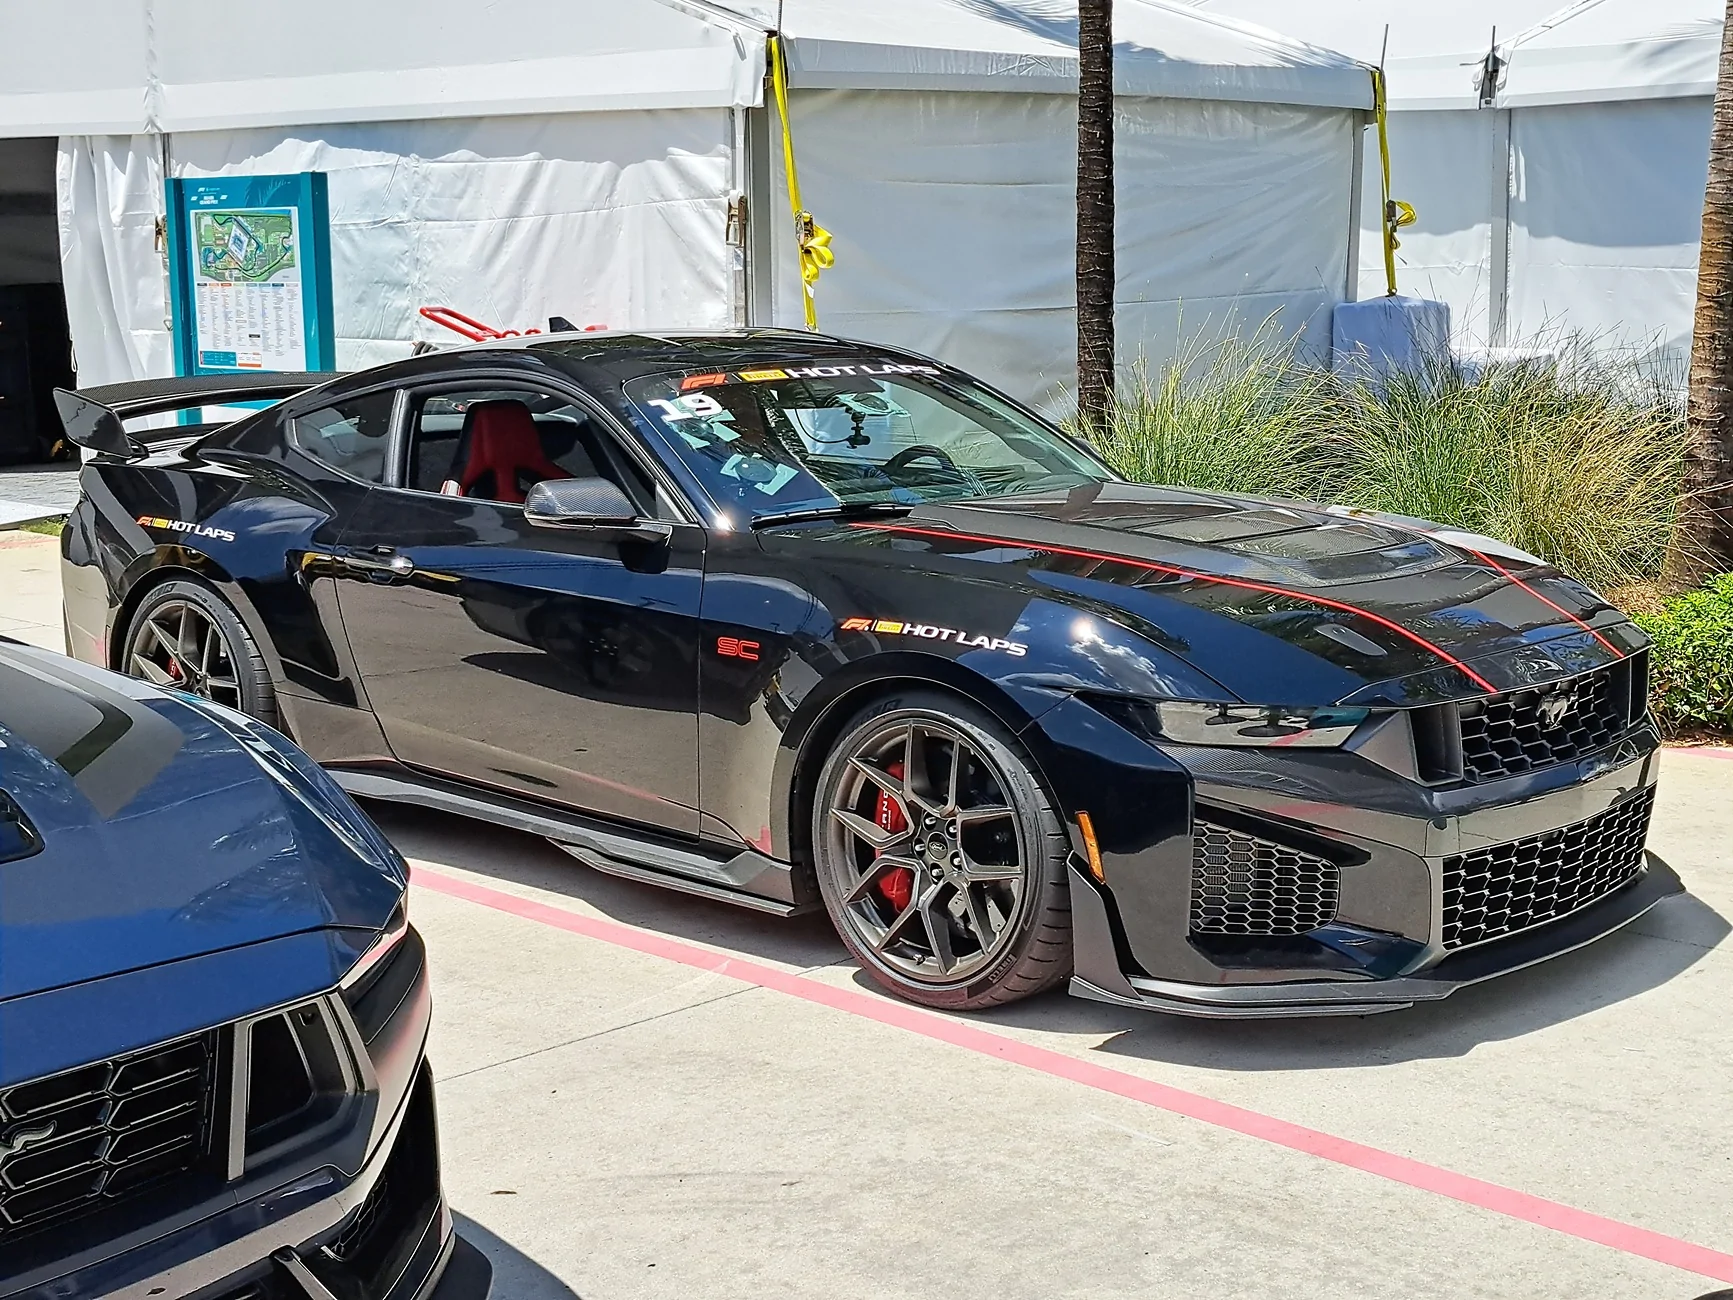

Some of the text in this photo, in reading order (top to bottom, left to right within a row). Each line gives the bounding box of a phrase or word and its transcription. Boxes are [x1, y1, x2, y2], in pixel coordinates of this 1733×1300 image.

[785, 366, 857, 378] HOT
[860, 364, 941, 375] LAPS
[647, 393, 723, 422] 19
[167, 519, 196, 533] HOT
[194, 524, 236, 542] LAPS
[717, 636, 759, 660] SC
[902, 623, 956, 640] HOT
[957, 631, 1028, 656] LAPS
